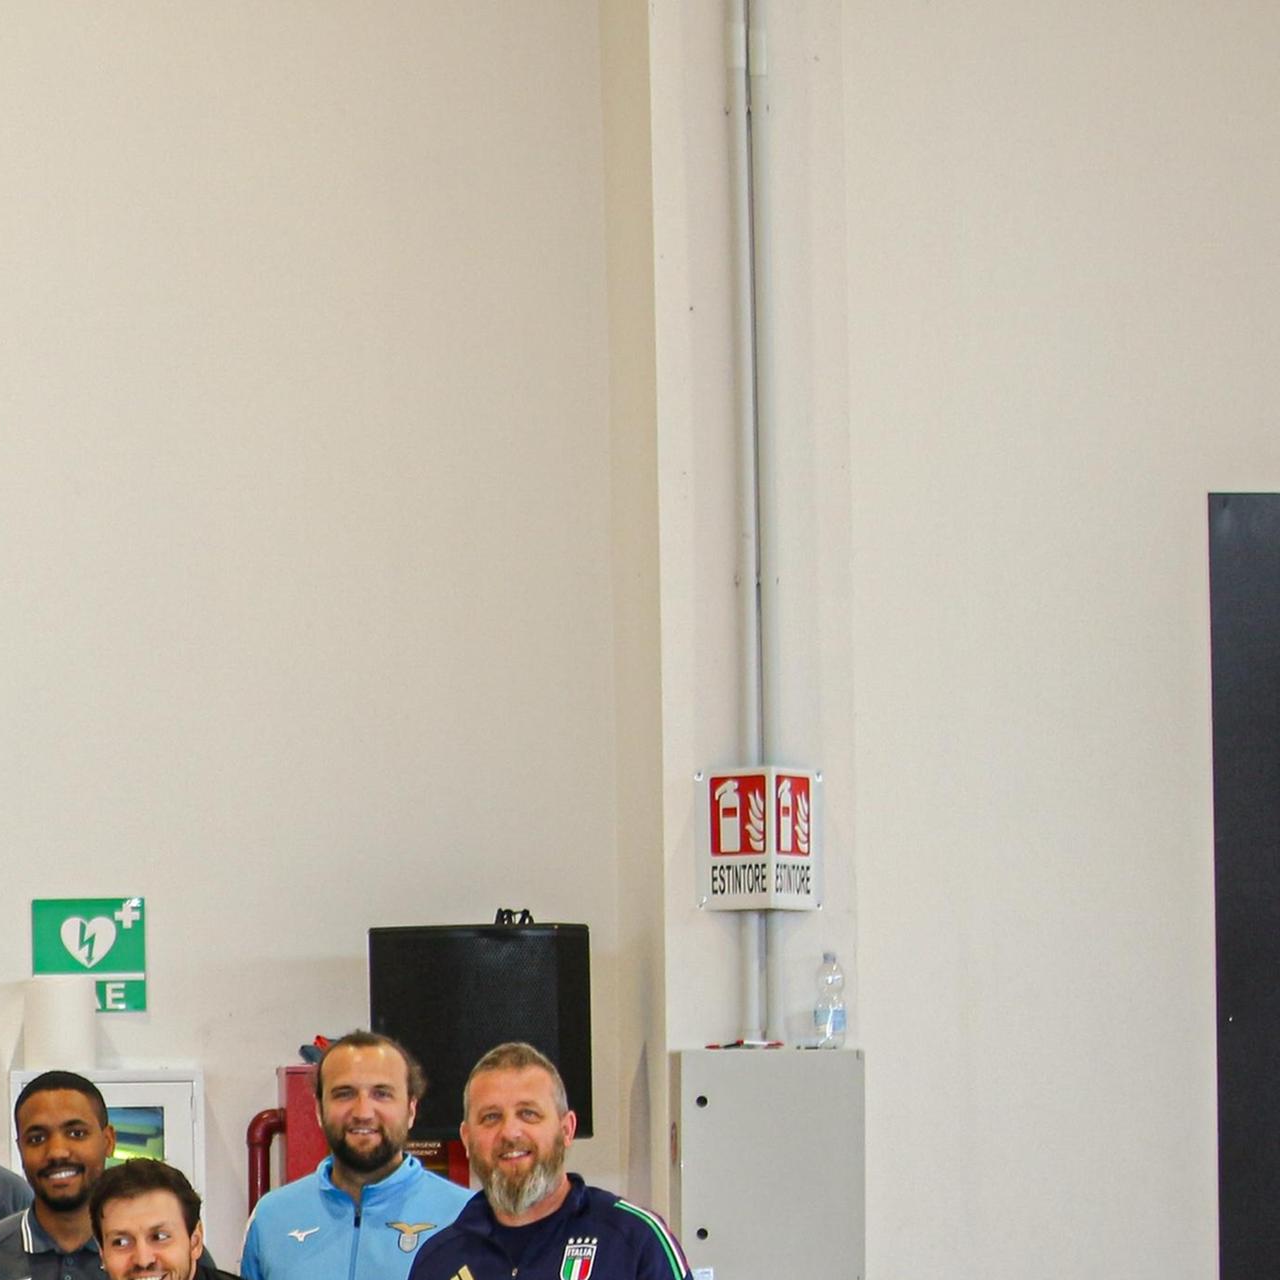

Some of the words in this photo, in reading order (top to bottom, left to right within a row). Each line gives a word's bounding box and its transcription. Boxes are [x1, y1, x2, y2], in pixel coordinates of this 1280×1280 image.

[711, 863, 767, 895] ESTINTORE
[775, 863, 811, 895] ESTINTORE
[566, 1247, 592, 1257] ITALIA
